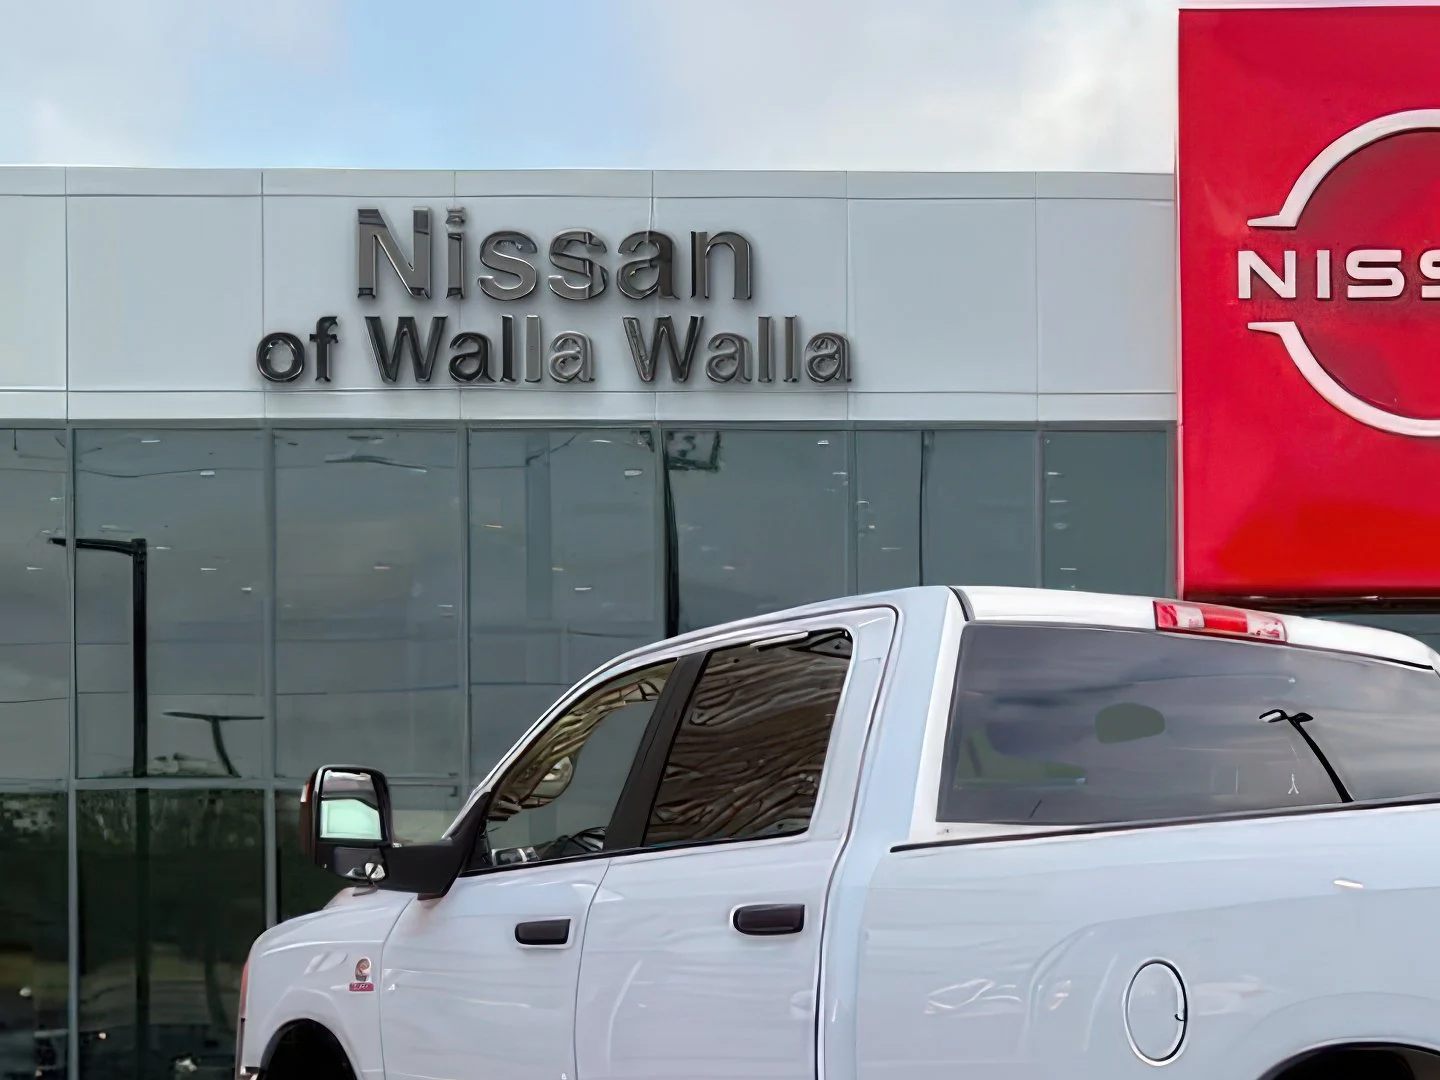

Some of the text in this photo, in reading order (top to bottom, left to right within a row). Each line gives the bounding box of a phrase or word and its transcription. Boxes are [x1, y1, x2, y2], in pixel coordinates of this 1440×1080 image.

[356, 206, 753, 300] Nissan
[255, 314, 853, 384] of Walla Walla
